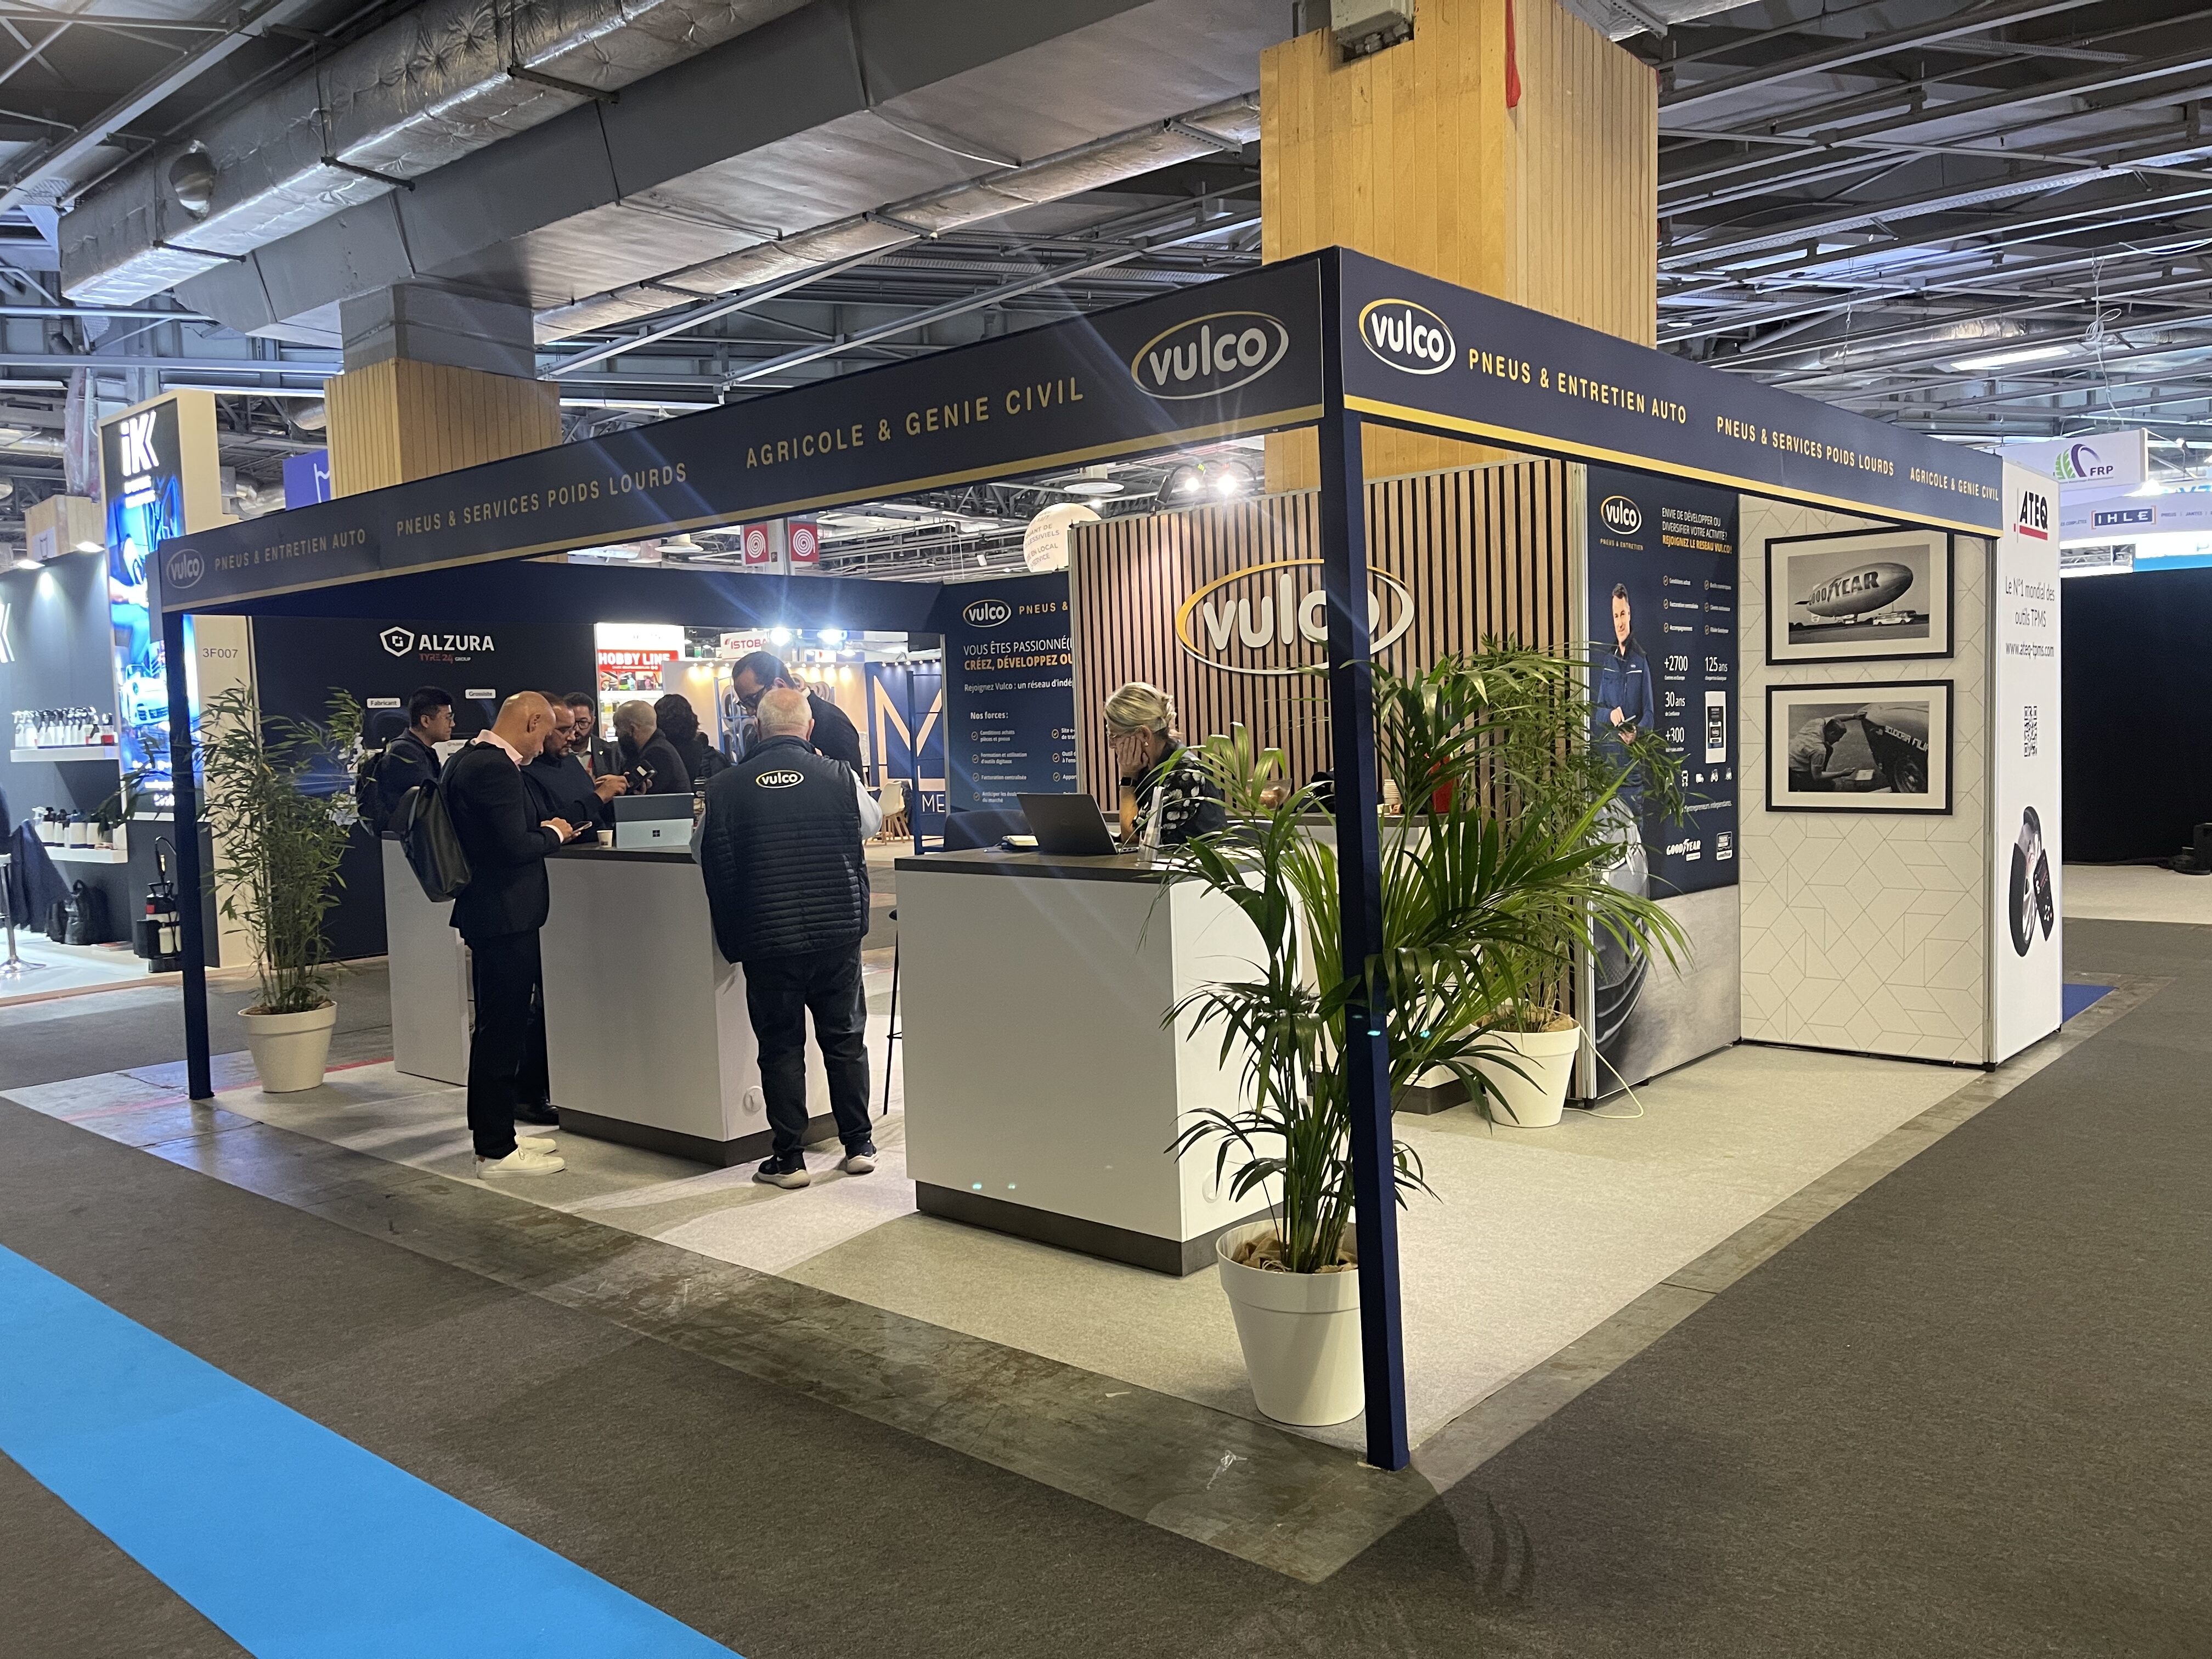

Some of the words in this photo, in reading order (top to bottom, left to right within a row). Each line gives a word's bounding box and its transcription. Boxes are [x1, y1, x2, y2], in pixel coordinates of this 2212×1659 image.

[1372, 309, 1445, 362] vulco
[1149, 325, 1267, 386] vulco
[1469, 348, 1531, 383] PNEUS
[1541, 368, 1549, 388] &
[1558, 373, 1645, 413] ENTRETIEN
[1652, 398, 1686, 424] AUTO
[746, 424, 865, 469] AGRICOLE
[878, 420, 891, 442] &
[906, 396, 990, 436] GENIE
[1006, 377, 1084, 416] CIVIL
[1717, 416, 1756, 442] PNEUS
[1761, 429, 1768, 444] &
[1772, 431, 1822, 459] SERVICES
[1826, 445, 1855, 466] POIDS
[1859, 454, 1894, 476] LOURDS
[2090, 465, 2114, 476] FRP
[1910, 467, 1948, 489] AGRICOLE
[1951, 478, 1955, 490] &
[1958, 479, 1979, 496] GENIE
[1982, 486, 1999, 501] CIVIL
[397, 514, 441, 537] PNEUS
[448, 511, 456, 526] &
[464, 493, 539, 524] SERVICES
[549, 481, 599, 507] POIDS
[610, 462, 686, 495] LOURDS
[1606, 500, 1637, 527] vulco
[1662, 507, 1676, 519] ENVIE
[1677, 510, 1684, 521] DE
[1684, 509, 1713, 526] DÉVELOPPER
[1713, 517, 1721, 527] OU
[2019, 491, 2048, 530] ATEQ
[2098, 511, 2149, 524] IHLE
[1662, 521, 1690, 535] DIVERSIFIER
[1690, 526, 1705, 537] VOTRE
[215, 552, 249, 571] PNEUS
[253, 551, 259, 564] &
[265, 536, 327, 562] ENTRETIEN
[332, 528, 365, 549] AUTO
[1037, 543, 1058, 553] LOCAL
[1662, 534, 1689, 548] REJOIGNEZ
[1690, 539, 1695, 548] LE
[171, 554, 199, 580] vulco
[2005, 575, 2012, 594] Le
[2025, 582, 2045, 600] mondial
[2046, 584, 2055, 601] des
[969, 603, 1005, 621] vulco
[1019, 603, 1056, 614] PNEUS
[1062, 601, 1068, 611] &
[1203, 574, 1380, 650] vulc
[2015, 607, 2030, 625] outils
[2031, 609, 2046, 627] TPMS
[419, 635, 495, 651] ALZURA
[963, 644, 988, 656] VOUS
[990, 641, 1011, 654] ÊTES
[2006, 641, 2054, 659] www.ateq-tpms.com
[202, 648, 238, 658] 3F007
[599, 652, 641, 665] HOBBY
[964, 657, 995, 671] CRÉEZ,
[997, 654, 1058, 669] DÉVELOPPEZ
[1664, 655, 1688, 672] +2700
[1705, 657, 1718, 672] 125
[1718, 663, 1728, 672] ans
[964, 684, 994, 693] Rejoignez
[995, 682, 1013, 690] Vulco
[1028, 680, 1051, 689] réseau
[1665, 691, 1675, 707] 30
[1675, 697, 1685, 707] ans
[1666, 727, 1685, 743] +300
[761, 772, 798, 785] vulco
[923, 794, 945, 813] ME
[1666, 838, 1701, 855] GOODYEAR
